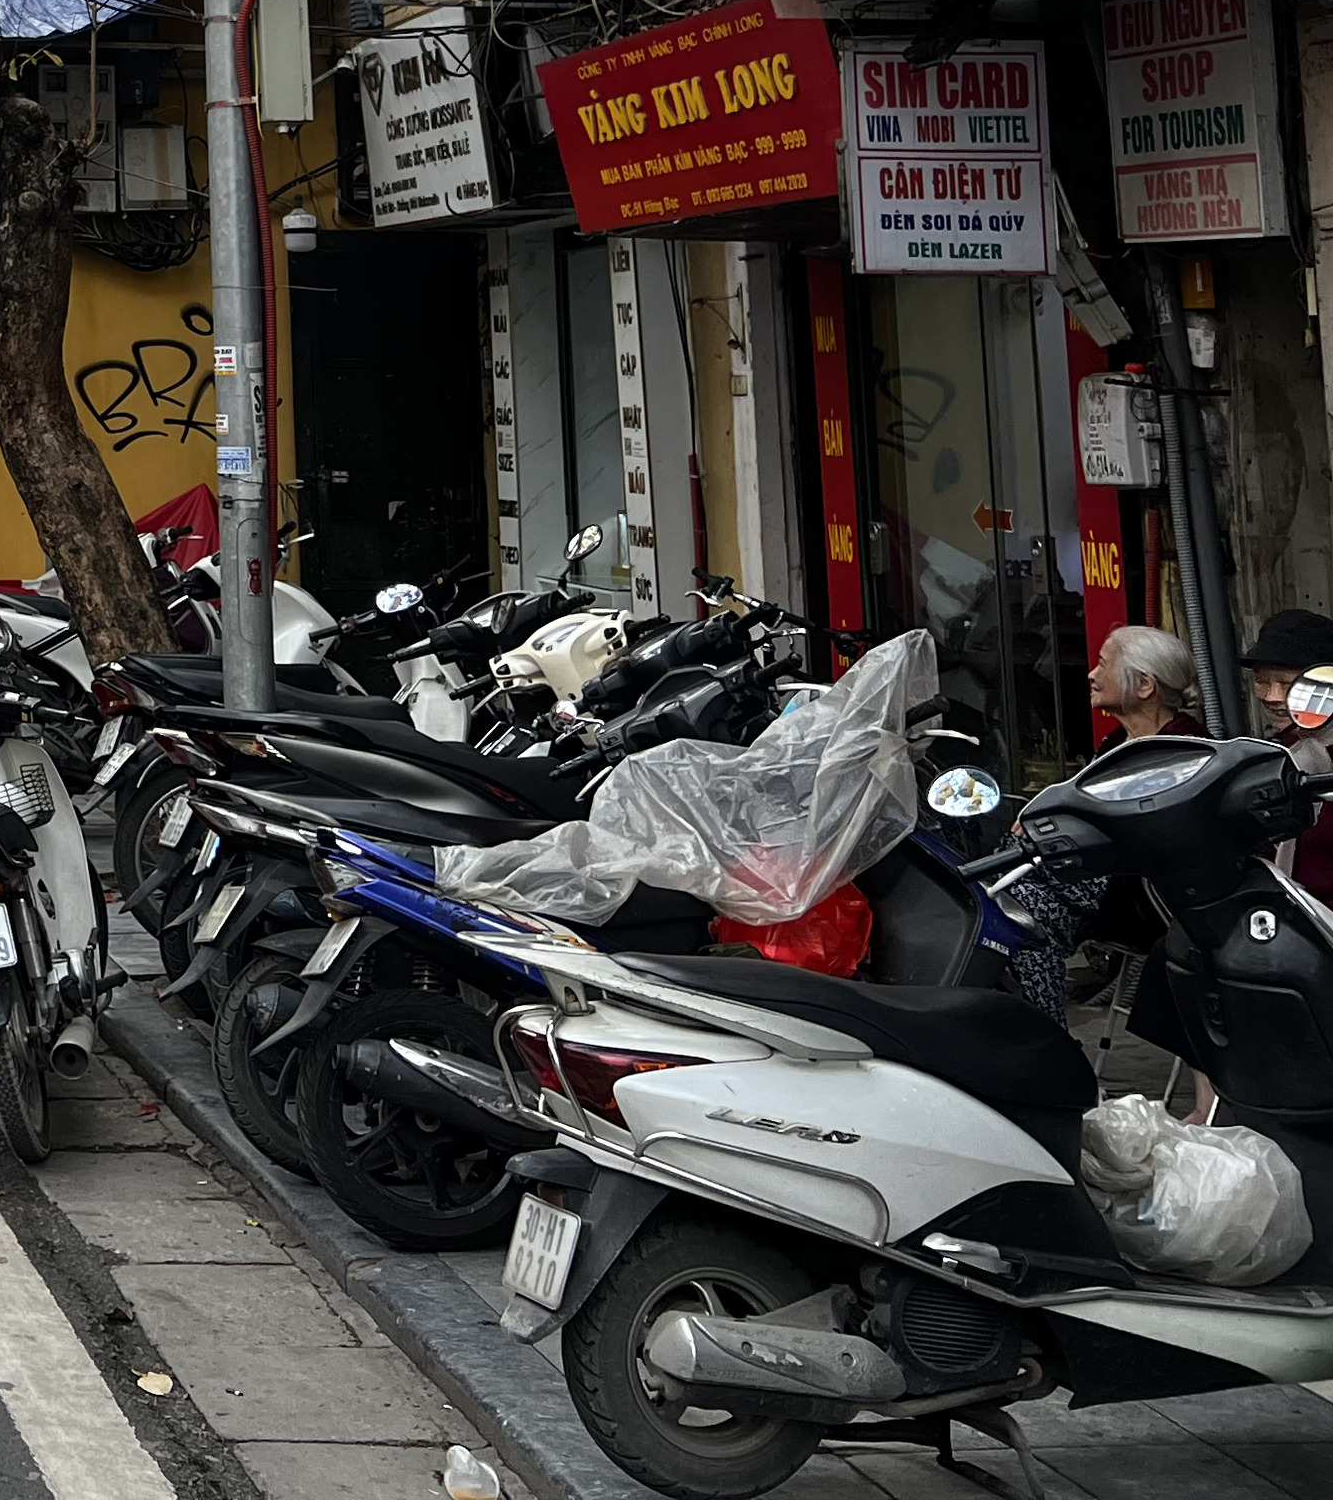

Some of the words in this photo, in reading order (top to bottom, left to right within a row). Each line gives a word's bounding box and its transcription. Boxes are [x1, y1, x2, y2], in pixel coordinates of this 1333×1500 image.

[578, 60, 603, 80] CÔNG
[605, 56, 618, 72] TY
[620, 48, 646, 67] TNHH
[648, 40, 674, 59] VÀNG
[678, 32, 698, 51] BẠC
[703, 21, 733, 42] CHÍNH
[736, 12, 764, 34] LONG
[578, 89, 647, 146] VÀNG
[651, 76, 710, 129] KIM
[715, 53, 796, 114] LONG
[863, 61, 928, 108] SIM
[936, 61, 1029, 109] CARD
[1141, 50, 1214, 103] SHOP
[866, 115, 902, 143] VINA
[917, 115, 955, 143] MOBI
[968, 115, 1029, 143] VIETTEL
[1122, 115, 1156, 154] FOR
[1159, 104, 1245, 151] TOURISM
[600, 168, 622, 186] MUA
[622, 160, 643, 181] BÁN
[693, 145, 723, 169] VÀNG
[725, 141, 749, 165] BẠC
[755, 136, 775, 156] 999
[879, 161, 925, 200] CÂN
[932, 161, 986, 205] ĐIỆN
[921, 214, 952, 231] SOI
[958, 209, 983, 231] ĐÁ
[949, 243, 1003, 260] LAZER
[617, 302, 634, 329] TỤC
[815, 316, 837, 352] MUA
[824, 409, 844, 456] BÁN
[828, 514, 853, 563] VÀNG
[1082, 530, 1120, 590] VÀNG
[521, 1203, 567, 1257] 30-H1
[511, 1245, 557, 1297] 9210
